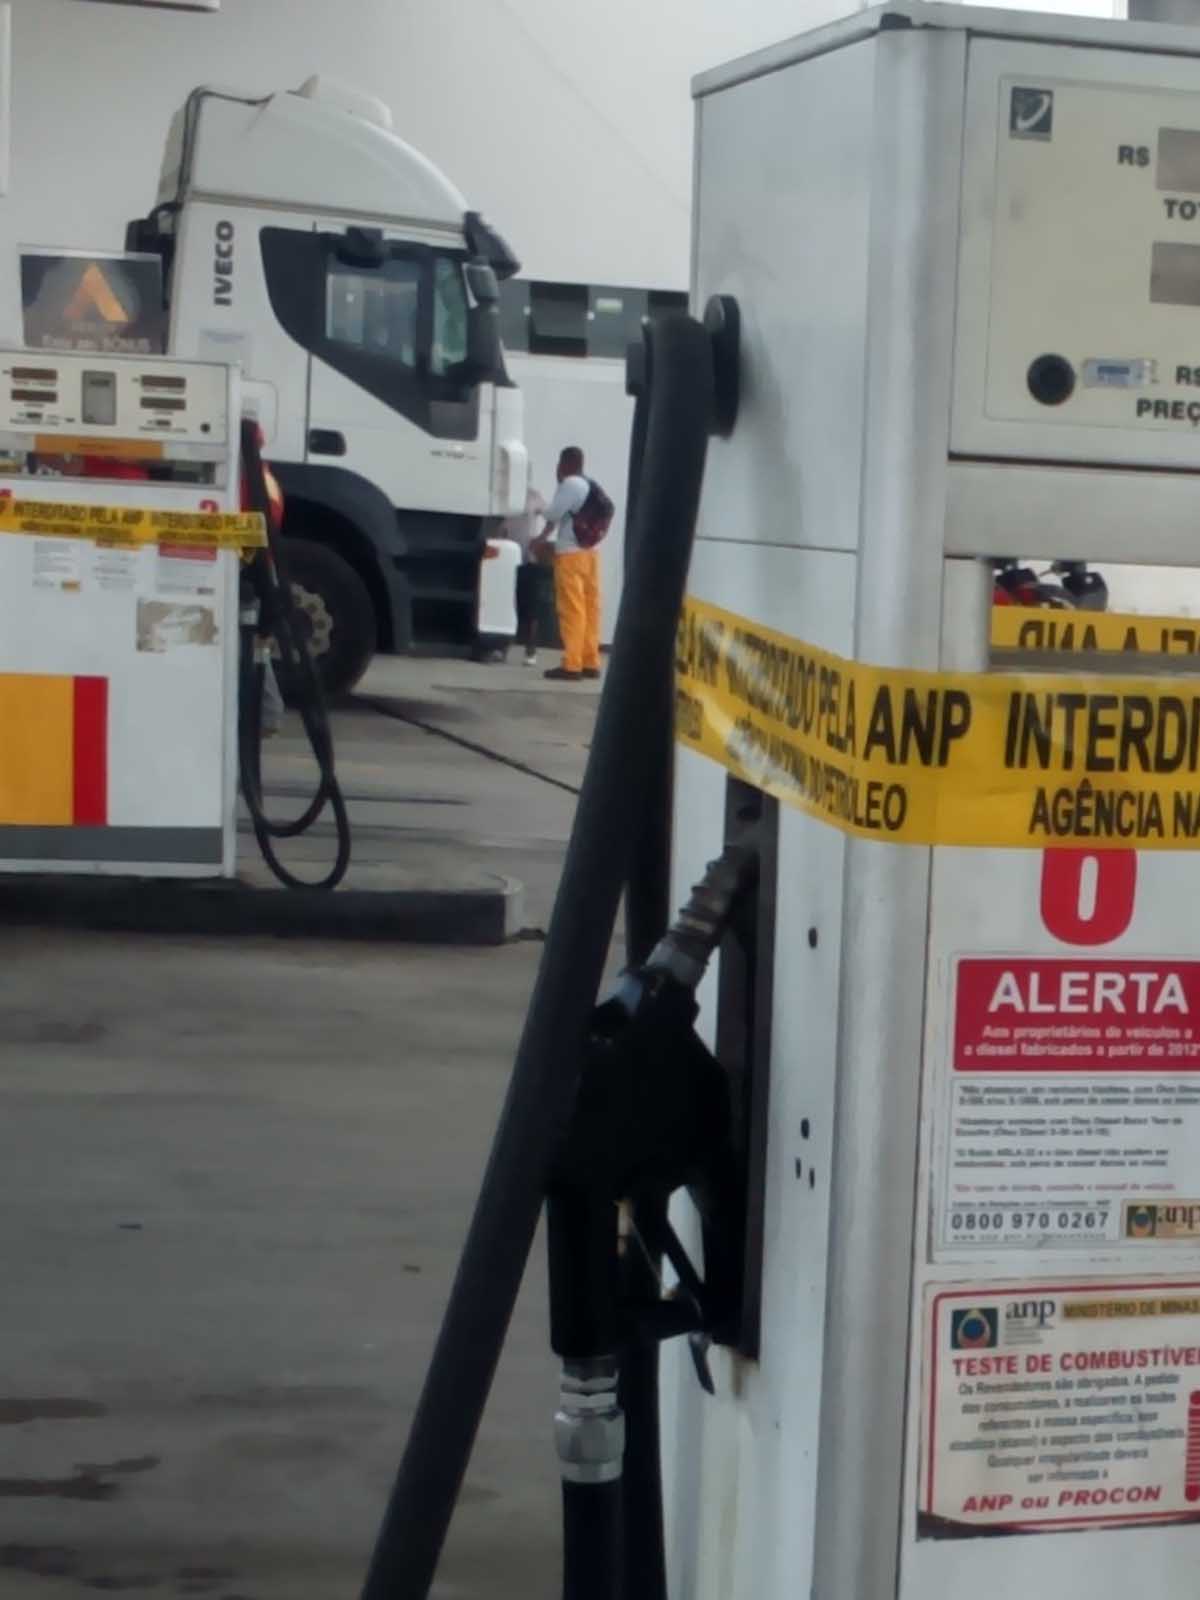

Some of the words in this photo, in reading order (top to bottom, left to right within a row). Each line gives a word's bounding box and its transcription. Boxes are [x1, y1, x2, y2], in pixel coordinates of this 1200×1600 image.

[213, 220, 234, 306] IVECO
[864, 683, 972, 769] ANP
[1029, 777, 1165, 839] AGÊNCIA
[988, 971, 1190, 1015] ALERTA
[951, 1213, 1004, 1230] 0800
[1011, 1213, 1050, 1229] 970
[1057, 1212, 1109, 1228] 0267
[1005, 1299, 1056, 1327] anp
[952, 1356, 1018, 1377] TESTE
[1025, 1354, 1053, 1373] DE
[962, 1493, 1014, 1513] ANP
[1021, 1494, 1050, 1510] ou
[1058, 1484, 1163, 1507] PROCON
